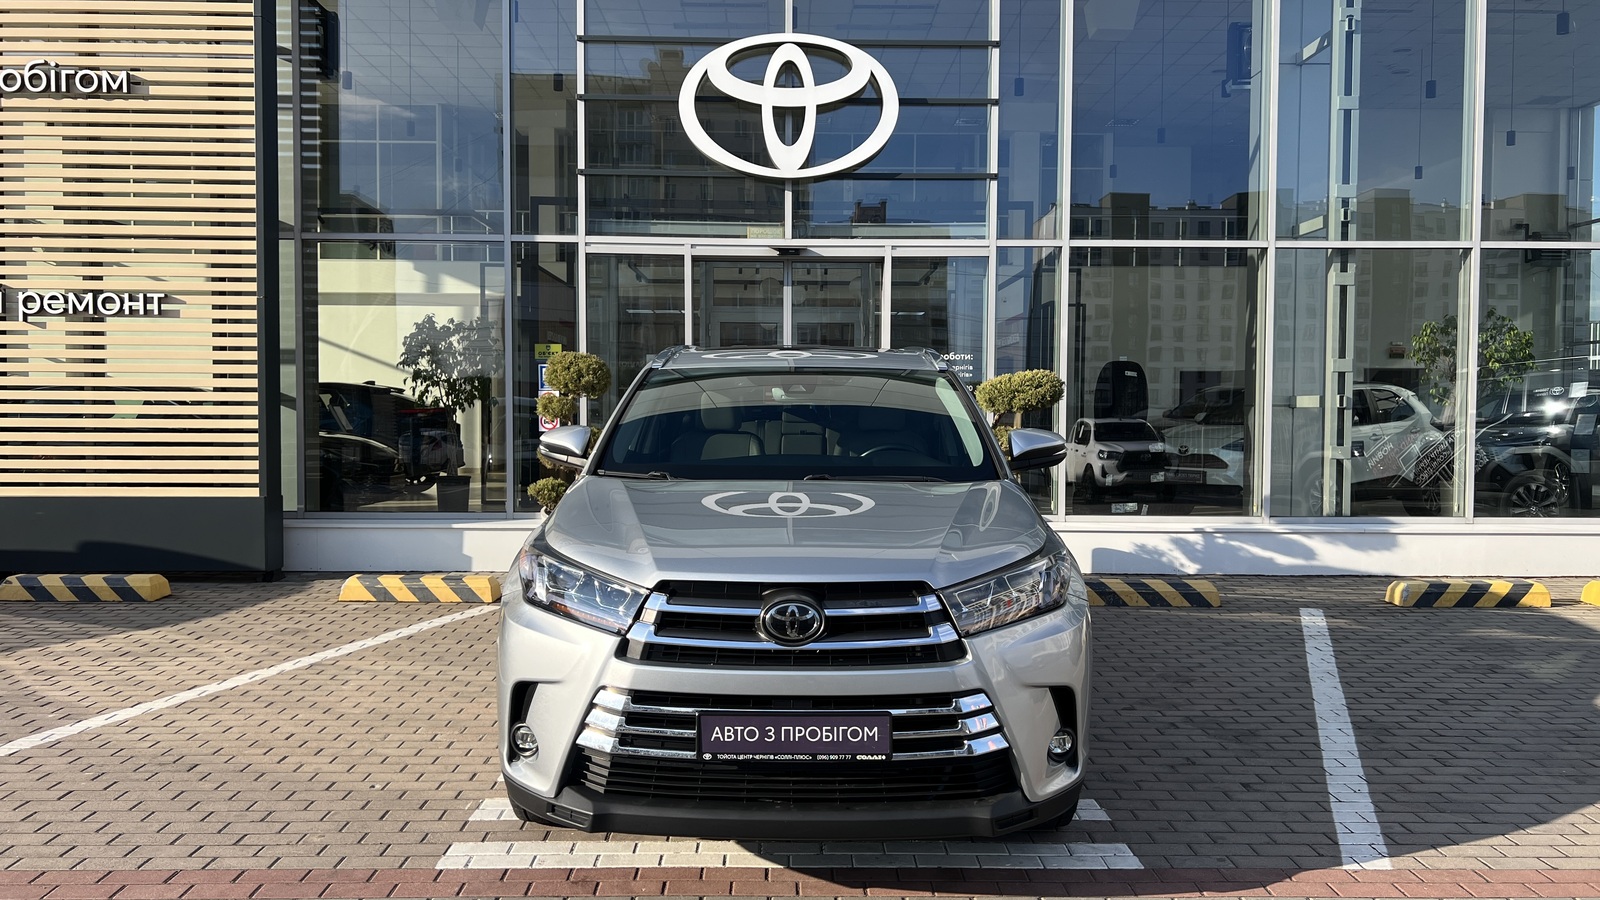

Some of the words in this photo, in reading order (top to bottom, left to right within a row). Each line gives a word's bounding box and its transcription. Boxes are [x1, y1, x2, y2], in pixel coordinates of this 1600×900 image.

[0, 59, 129, 93] обігом
[17, 291, 165, 322] ремонт
[710, 726, 759, 742] АВТО
[781, 726, 879, 742] ПРОБІГОМ
